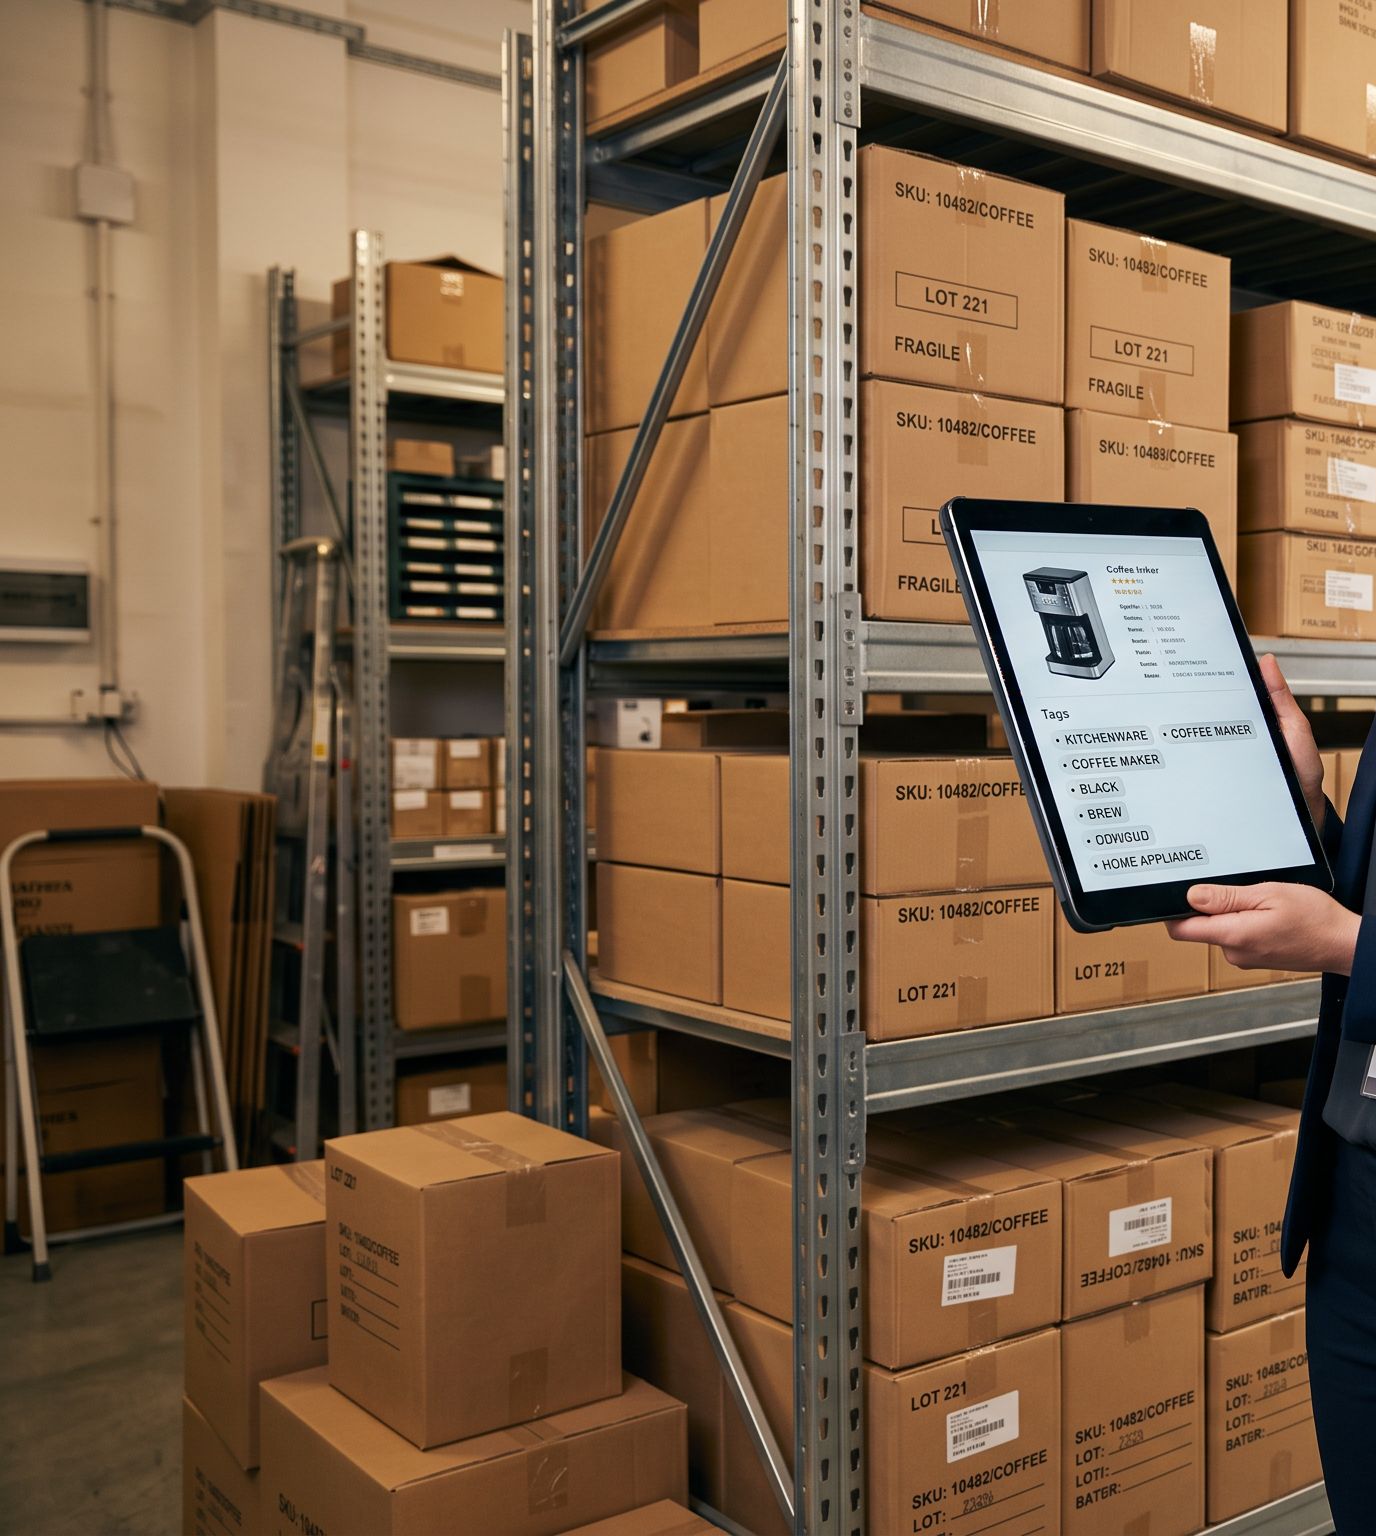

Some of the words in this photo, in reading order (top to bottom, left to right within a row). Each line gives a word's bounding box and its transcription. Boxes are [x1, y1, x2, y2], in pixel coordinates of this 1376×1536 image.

[895, 182, 931, 204] SKU:
[935, 192, 1034, 229] 10482/COFFEE
[1089, 248, 1119, 268] SKU:
[925, 287, 958, 308] LOT
[962, 295, 988, 314] 221
[895, 336, 960, 362] FRAGILE
[1114, 339, 1142, 358] LOT
[1146, 346, 1168, 363] 221
[1088, 377, 1144, 400] FRAGILE
[896, 412, 932, 431] SKU:
[937, 418, 1036, 444] 10482/COFFEE
[1099, 440, 1129, 456] SKU:
[1041, 708, 1070, 722] Tags
[1064, 730, 1148, 746] KITCHENWARE
[1170, 728, 1213, 740] COFFEE
[1214, 724, 1252, 736] MAKER
[1072, 757, 1118, 770] COFFEE
[1120, 754, 1160, 767] MAKER
[896, 784, 932, 800] SKU:
[1080, 782, 1119, 795] BLACK
[1088, 806, 1122, 820] BREW
[1102, 856, 1138, 870] HOME
[1140, 849, 1204, 866] APPLIANCE
[898, 906, 935, 924] SKU:
[939, 897, 1040, 920] 10482/COFFEE
[1075, 964, 1101, 981] LOT
[1104, 960, 1126, 978] 221
[898, 985, 928, 1003] LOT
[932, 982, 956, 999] 221
[909, 1233, 945, 1254] SKU:
[1233, 1226, 1260, 1244] SKU:
[1176, 1244, 1204, 1262] SKU:
[1226, 1373, 1252, 1392] SKU:
[912, 1390, 940, 1412] LOT
[944, 1381, 966, 1402] 221
[1226, 1394, 1251, 1412] LOT:
[1076, 1424, 1106, 1444] SKU:
[1109, 1390, 1194, 1432] 10482/COFFEE
[1076, 1446, 1104, 1466] LOT:
[912, 1487, 946, 1510] SKU:
[952, 1449, 1048, 1495] 10482/COFFEE
[913, 1511, 946, 1533] LOT:
